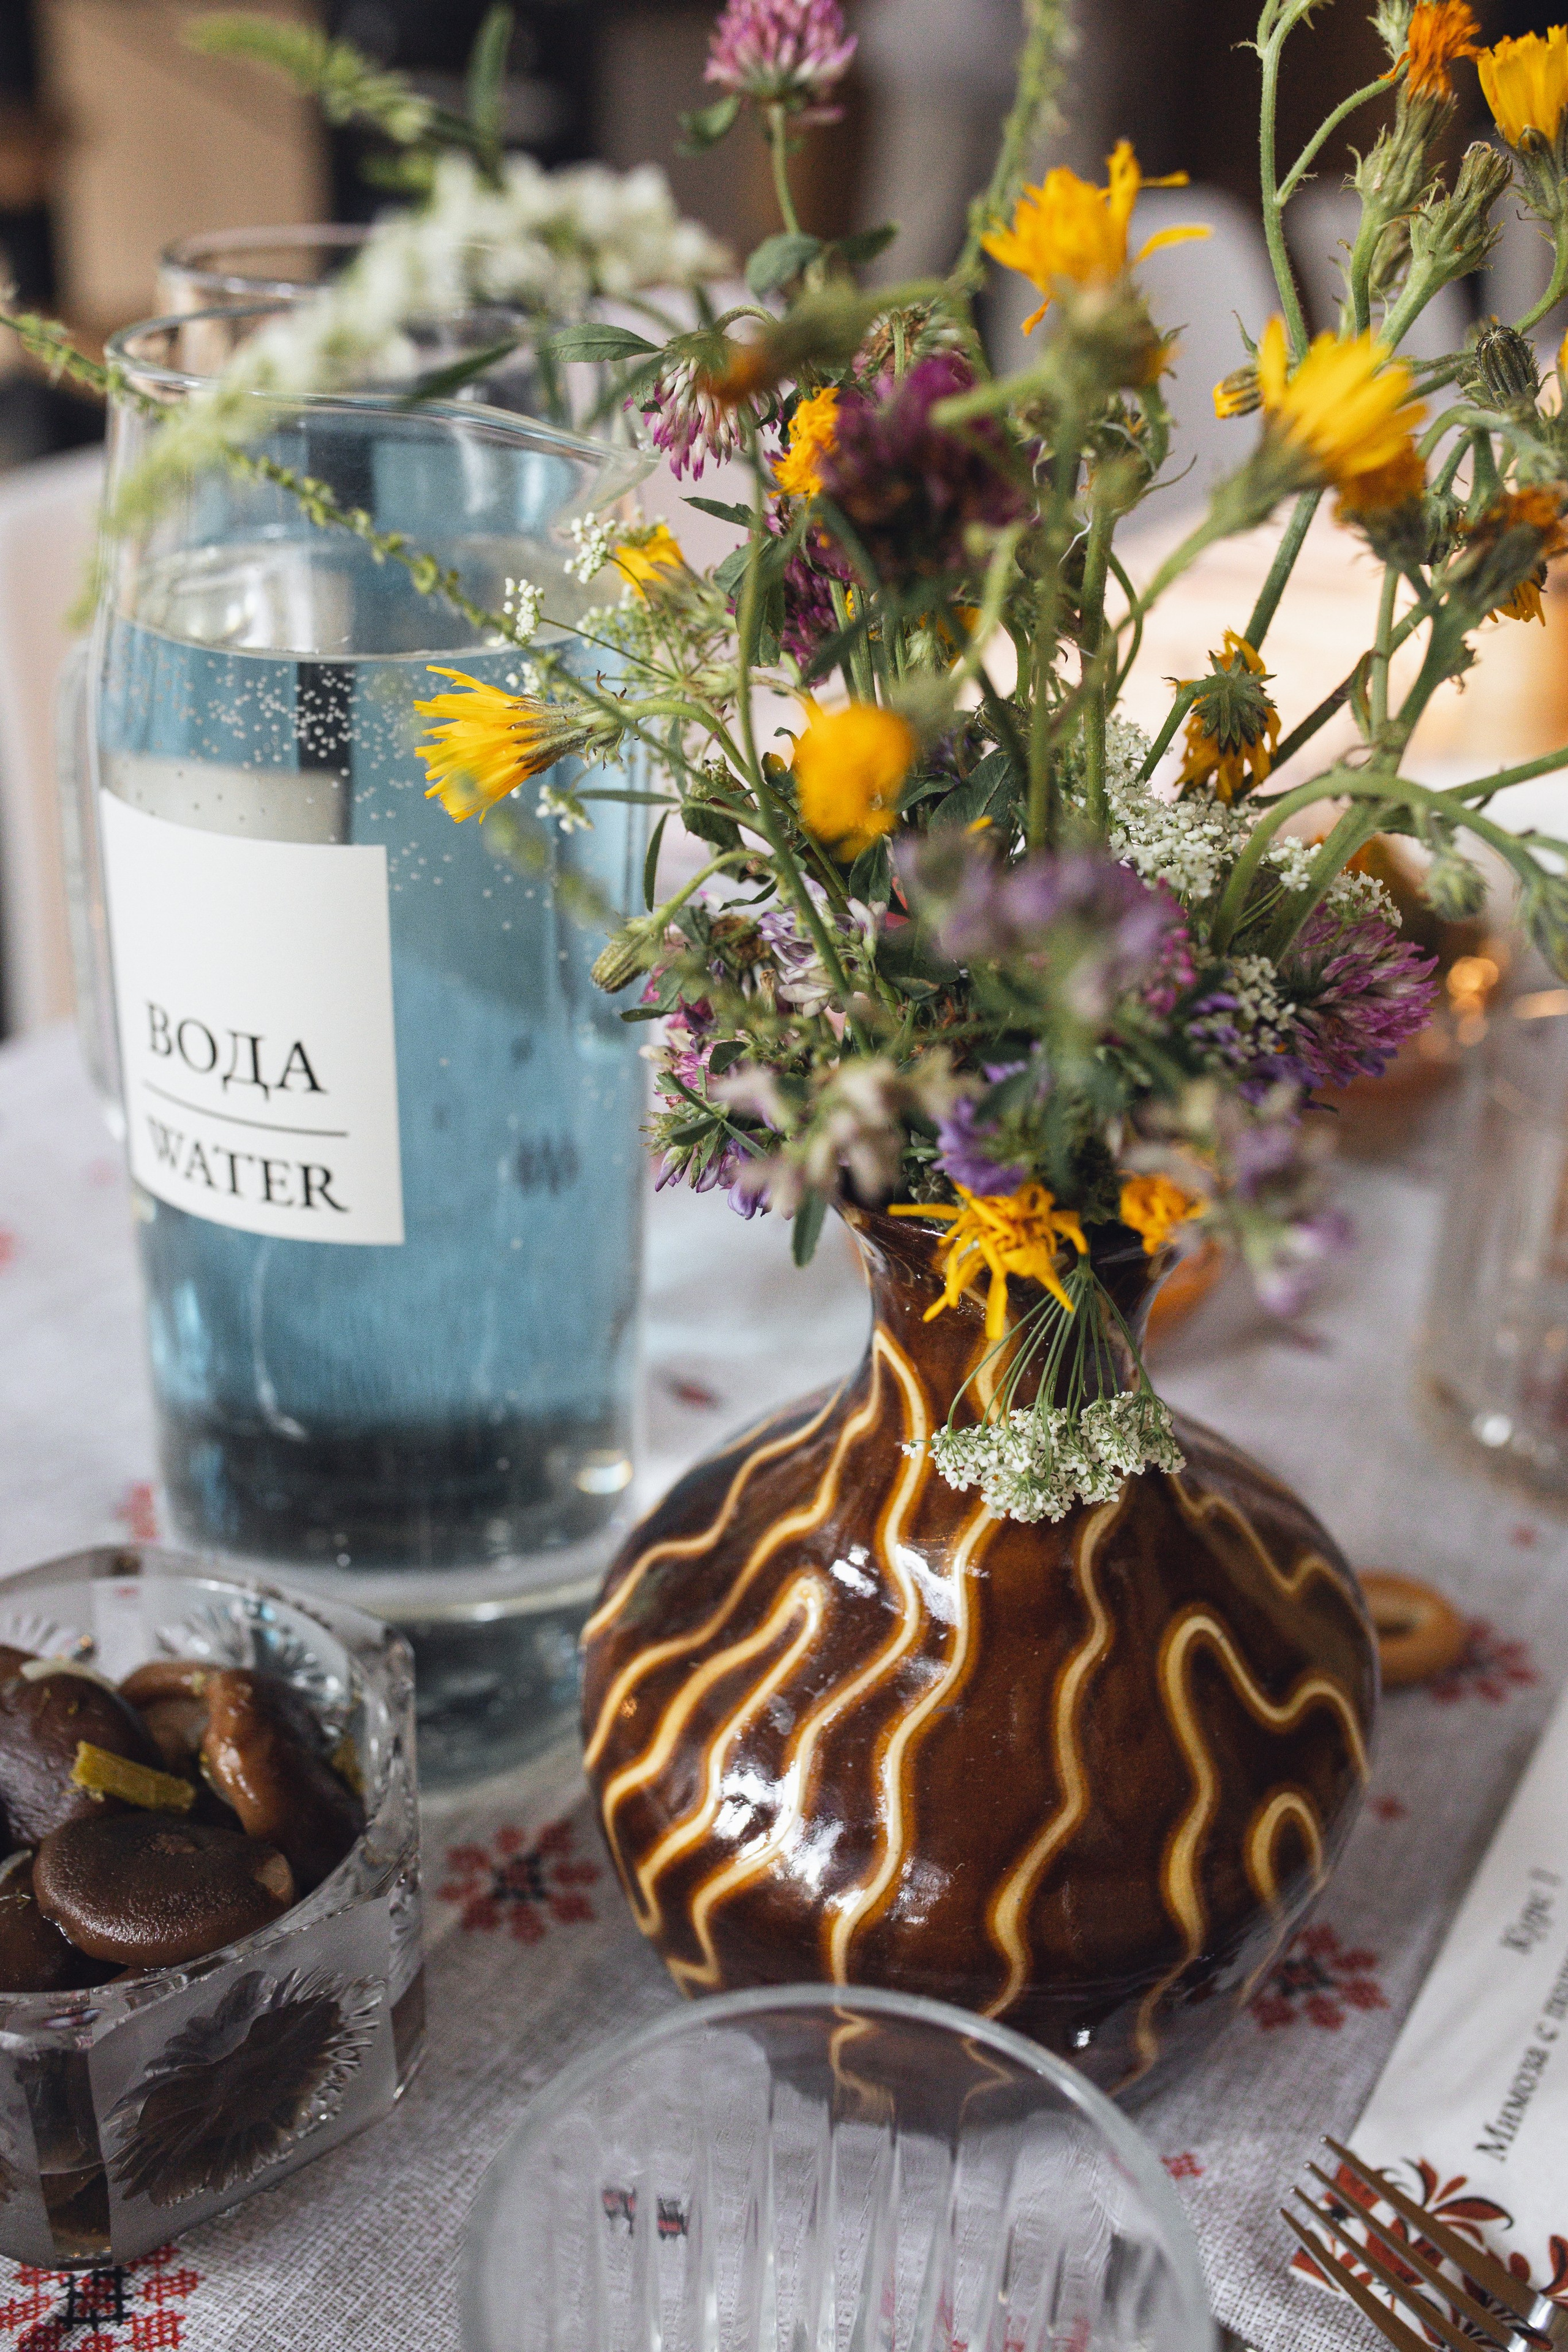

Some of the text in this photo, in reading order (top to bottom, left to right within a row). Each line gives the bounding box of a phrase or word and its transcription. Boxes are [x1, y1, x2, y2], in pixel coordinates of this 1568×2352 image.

[147, 1001, 328, 1101] ВОДА
[147, 1116, 350, 1212] WATER
[1474, 2045, 1550, 2163] Мимоза
